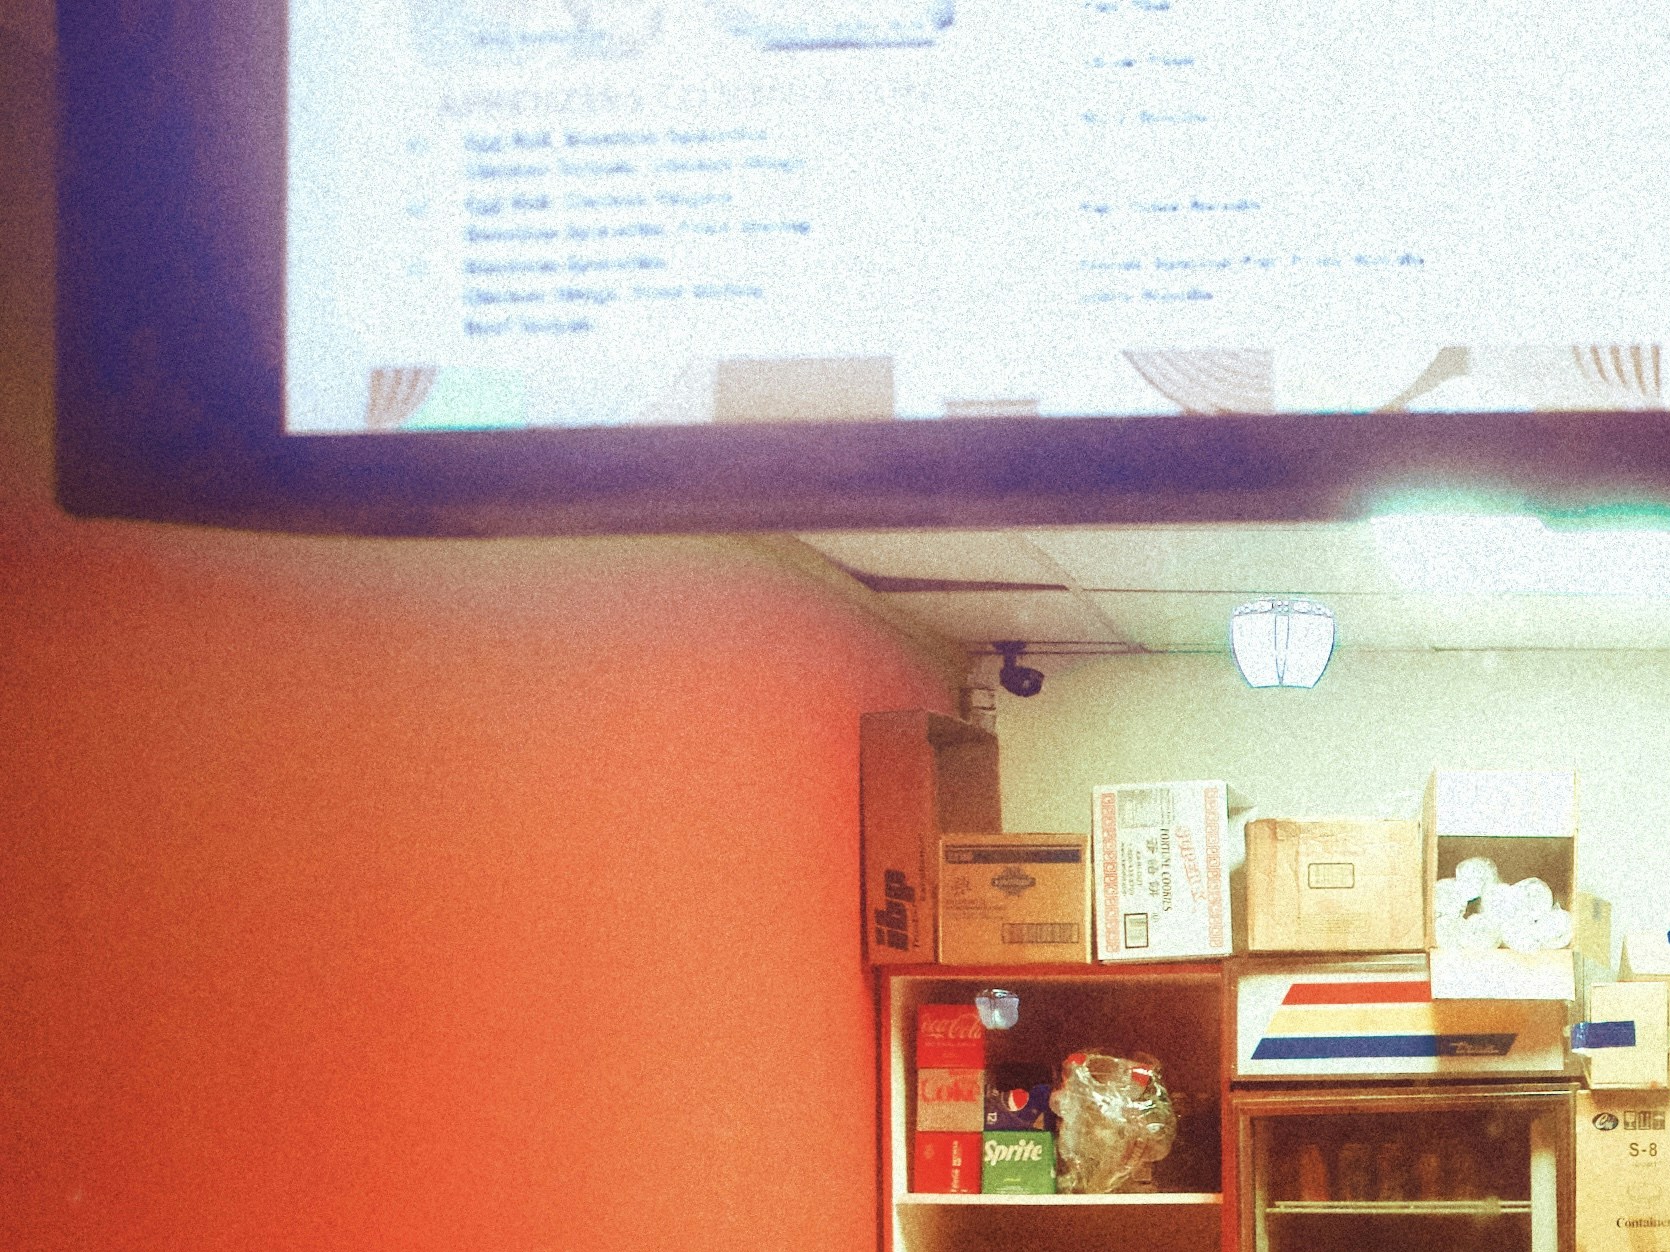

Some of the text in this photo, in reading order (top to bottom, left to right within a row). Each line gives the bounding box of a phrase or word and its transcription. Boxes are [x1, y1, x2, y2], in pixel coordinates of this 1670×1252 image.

[875, 868, 915, 951] ibp
[984, 1138, 1043, 1166] Sprite
[1629, 1142, 1658, 1157] S-8
